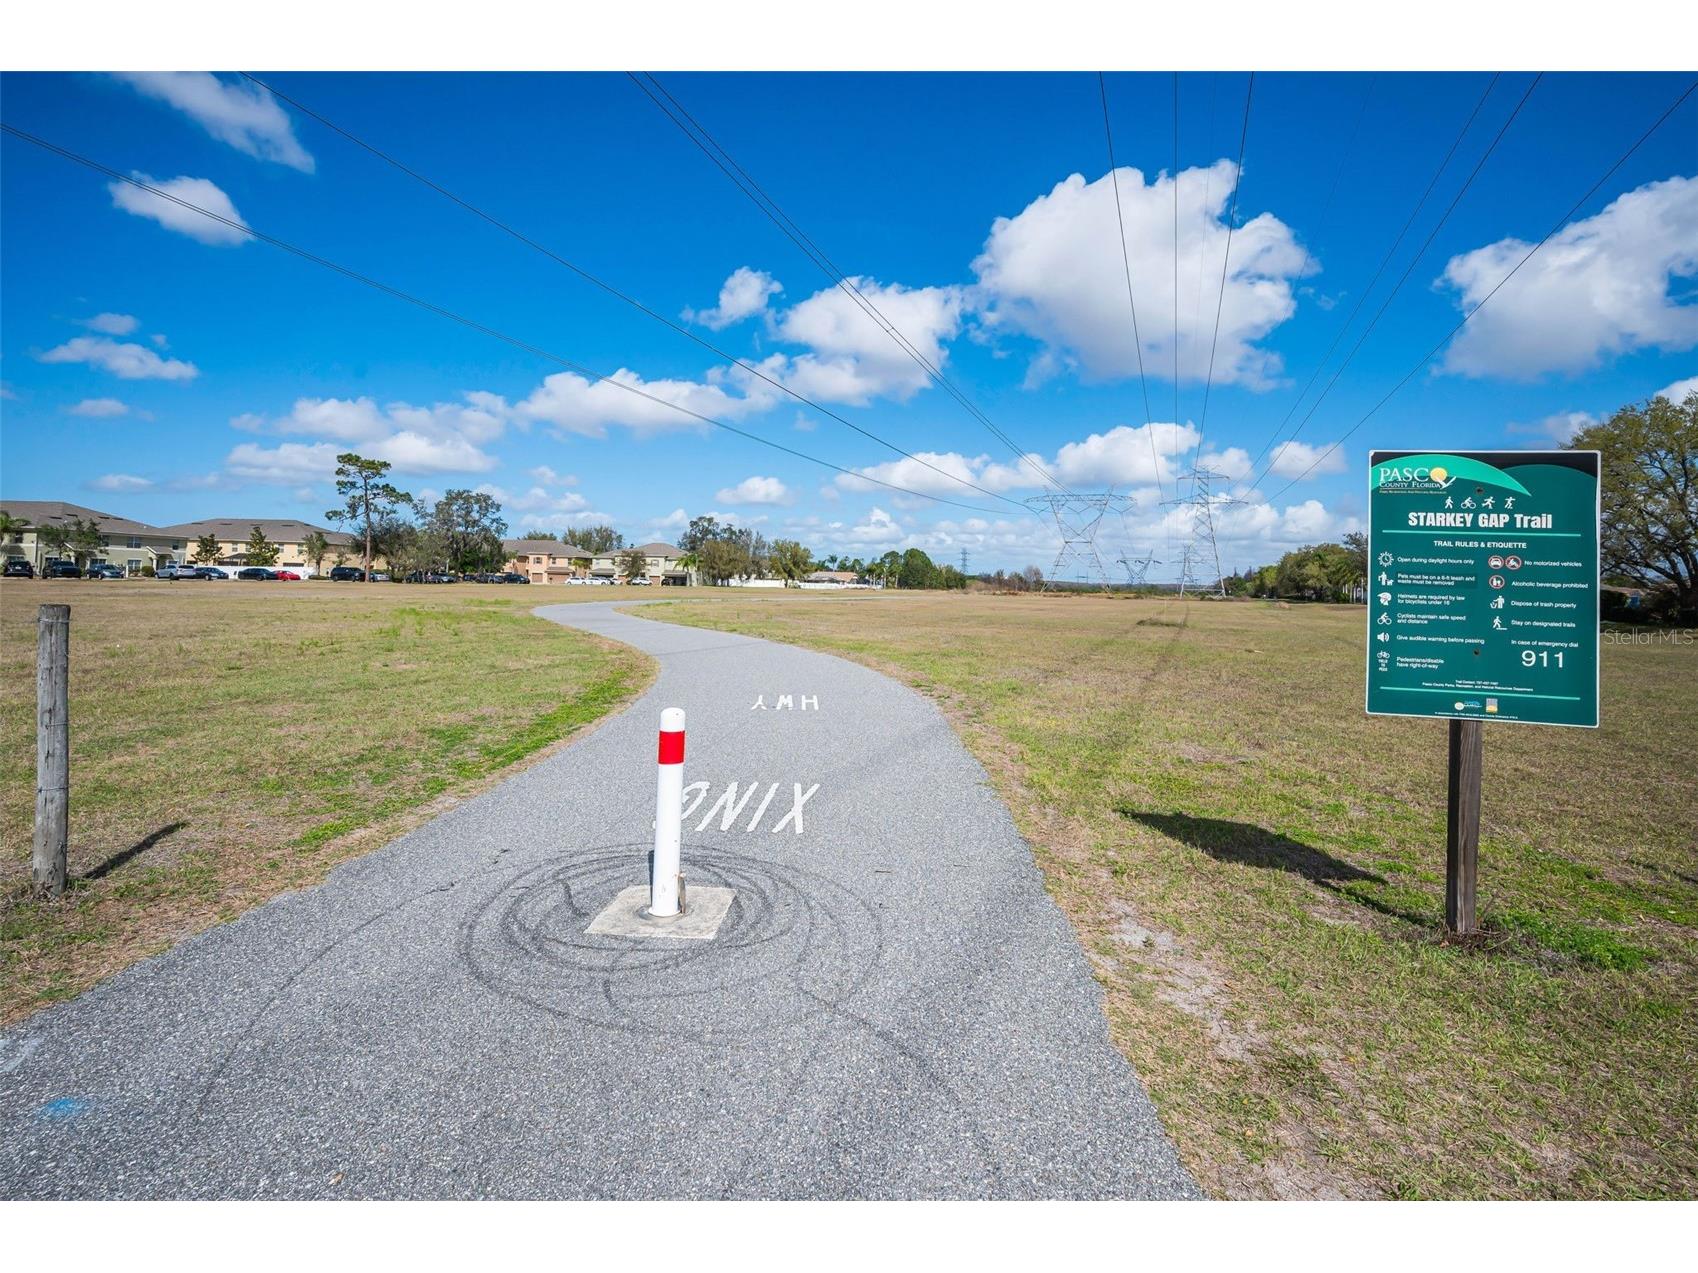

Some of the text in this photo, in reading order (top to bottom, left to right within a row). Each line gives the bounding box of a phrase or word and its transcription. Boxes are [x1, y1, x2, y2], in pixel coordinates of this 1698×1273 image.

[1408, 512, 1553, 529] STARKEY GAP Trail
[1560, 560, 1583, 568] vehicles
[1521, 650, 1564, 668] 911
[751, 694, 820, 711] HWY
